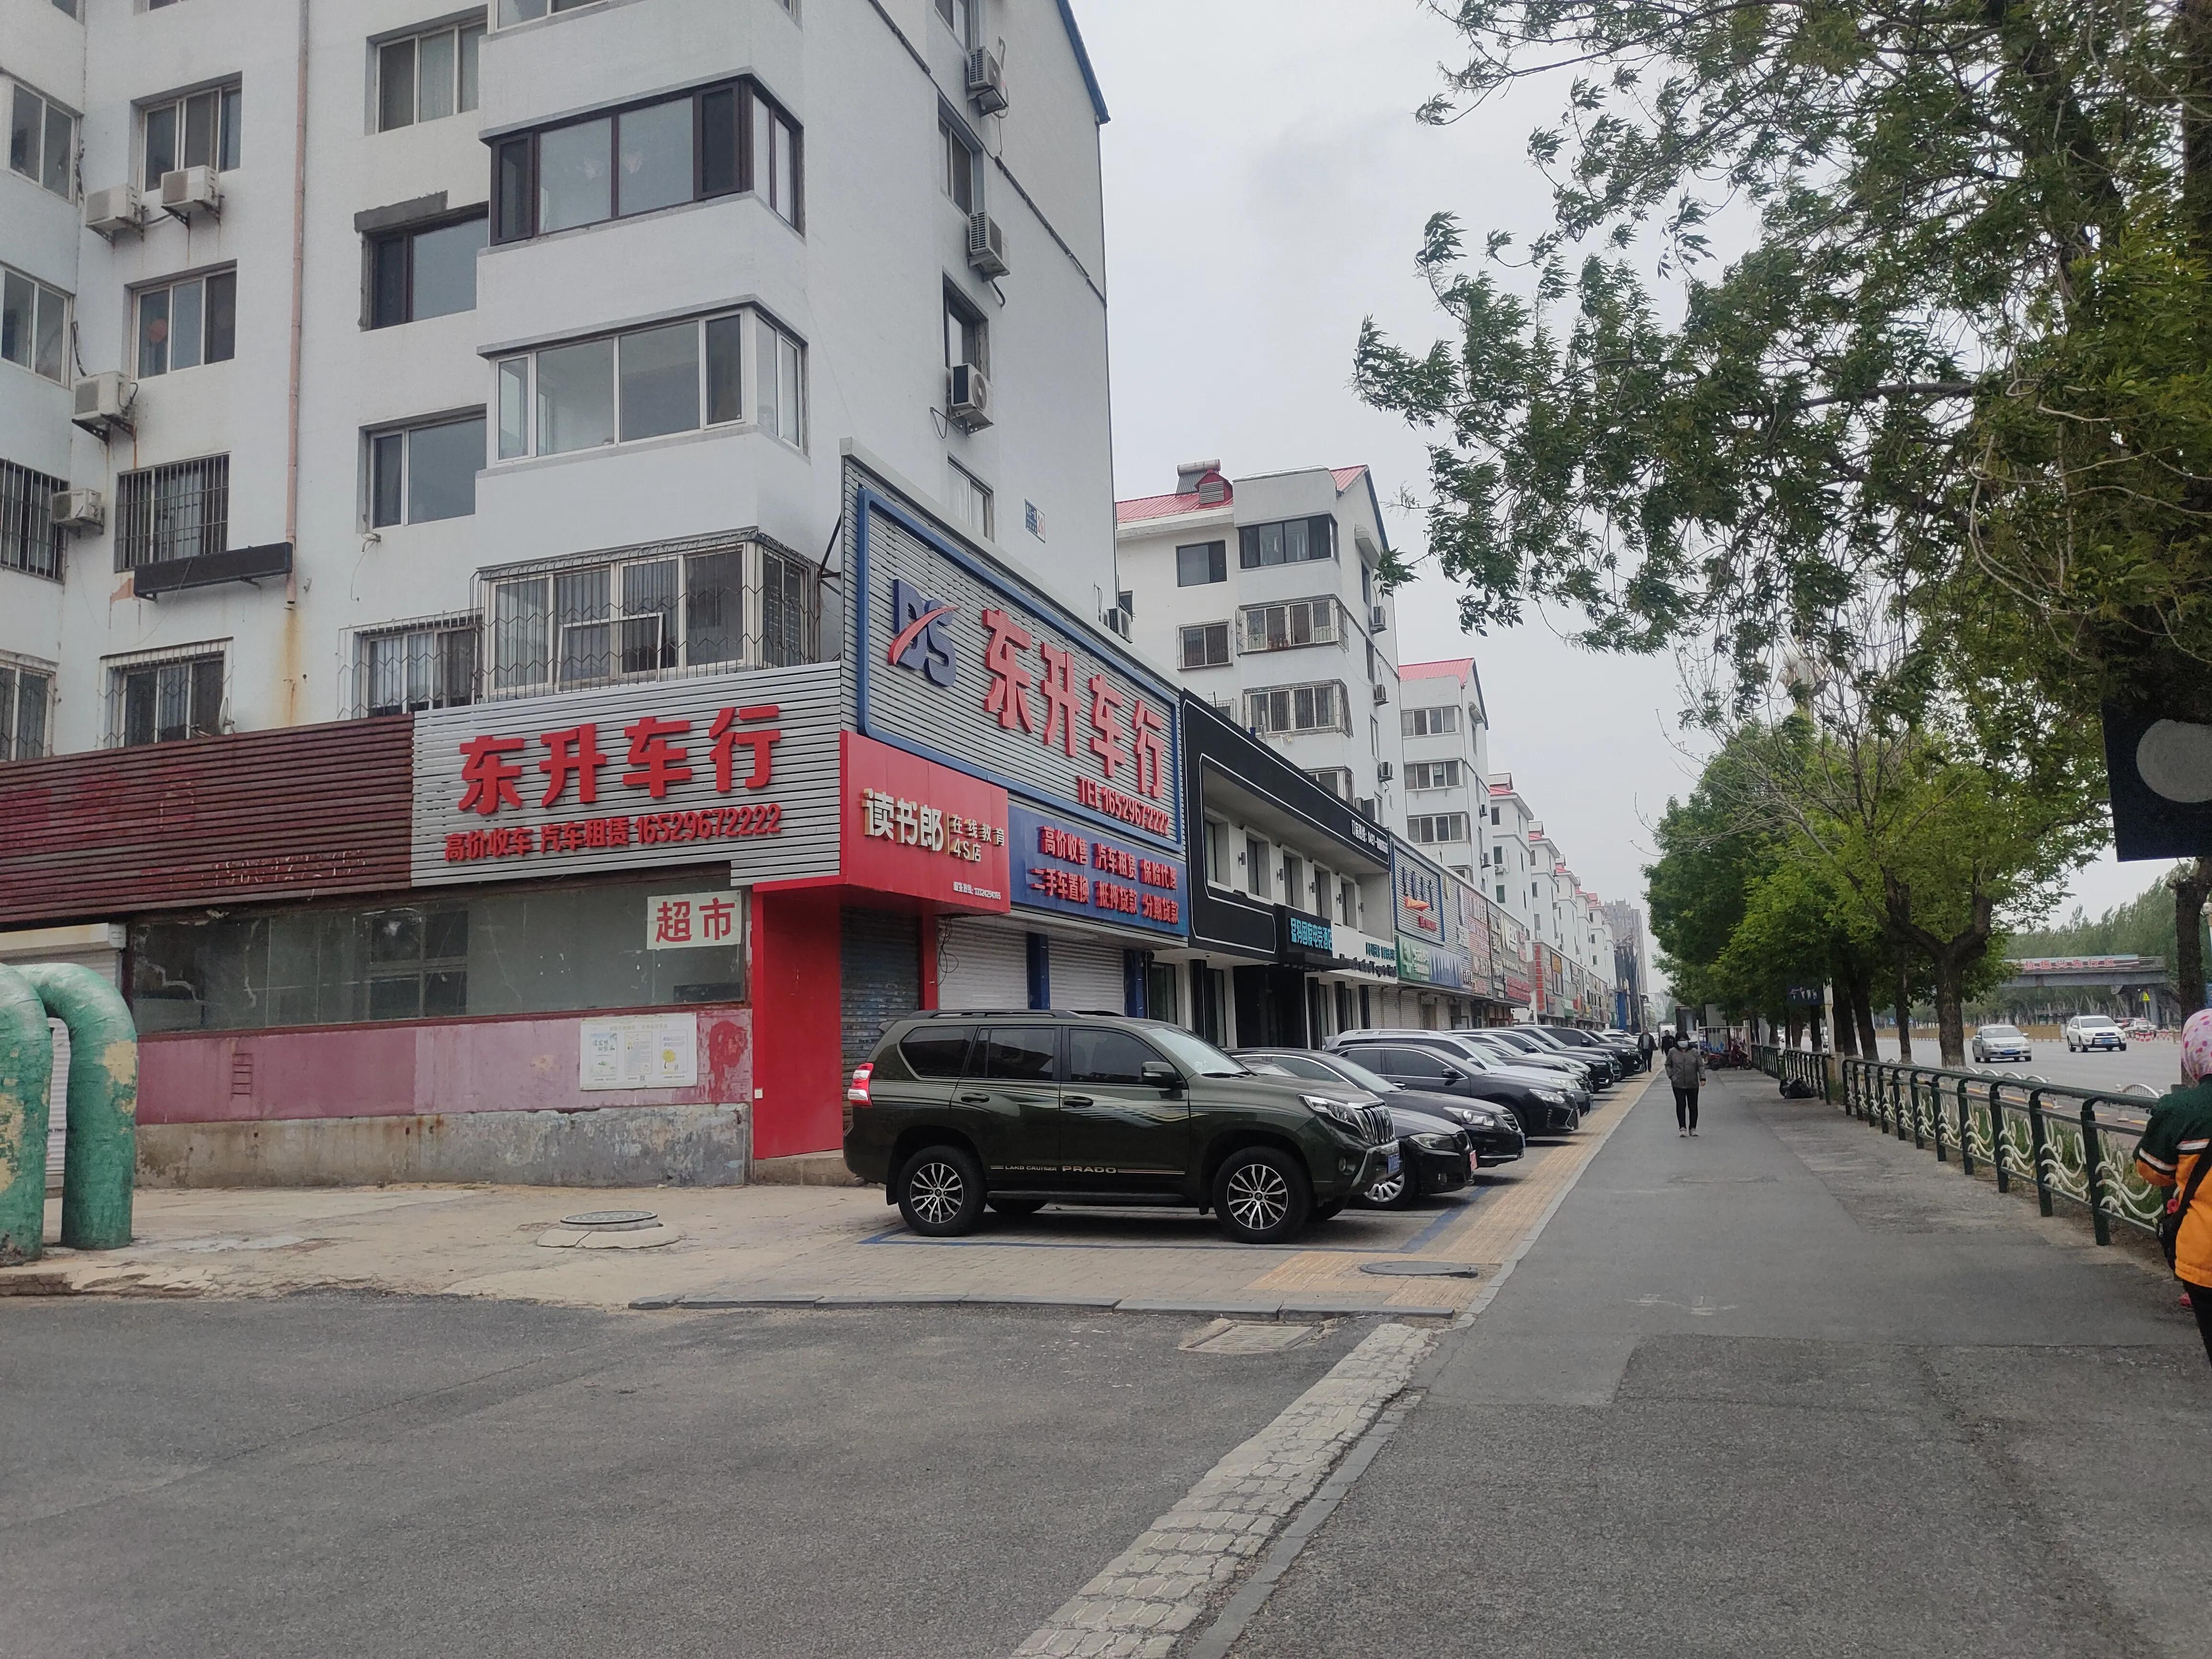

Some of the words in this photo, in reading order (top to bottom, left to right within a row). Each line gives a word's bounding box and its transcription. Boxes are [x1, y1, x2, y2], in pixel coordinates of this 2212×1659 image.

[893, 579, 957, 687] DS
[982, 609, 1166, 799] 东升车行
[458, 705, 781, 815] 东升车行
[445, 826, 534, 862] 高价收车
[540, 817, 630, 854] 汽车租赁
[634, 803, 782, 844] 16529672222
[862, 788, 944, 851] 读书郎
[949, 814, 1005, 846] 在线教育
[1101, 786, 1170, 835] 16529672222
[950, 838, 981, 862] 4S店
[1037, 825, 1088, 865] 高价收售
[1091, 842, 1137, 880] 汽车租赁
[1139, 858, 1178, 890] 保险代理
[655, 897, 735, 943] 超市
[1030, 868, 1090, 903] 二手车置换
[1095, 880, 1138, 914] 抵押贷款
[1141, 893, 1179, 924] 分期贷款
[1062, 1166, 1117, 1174] PRADO
